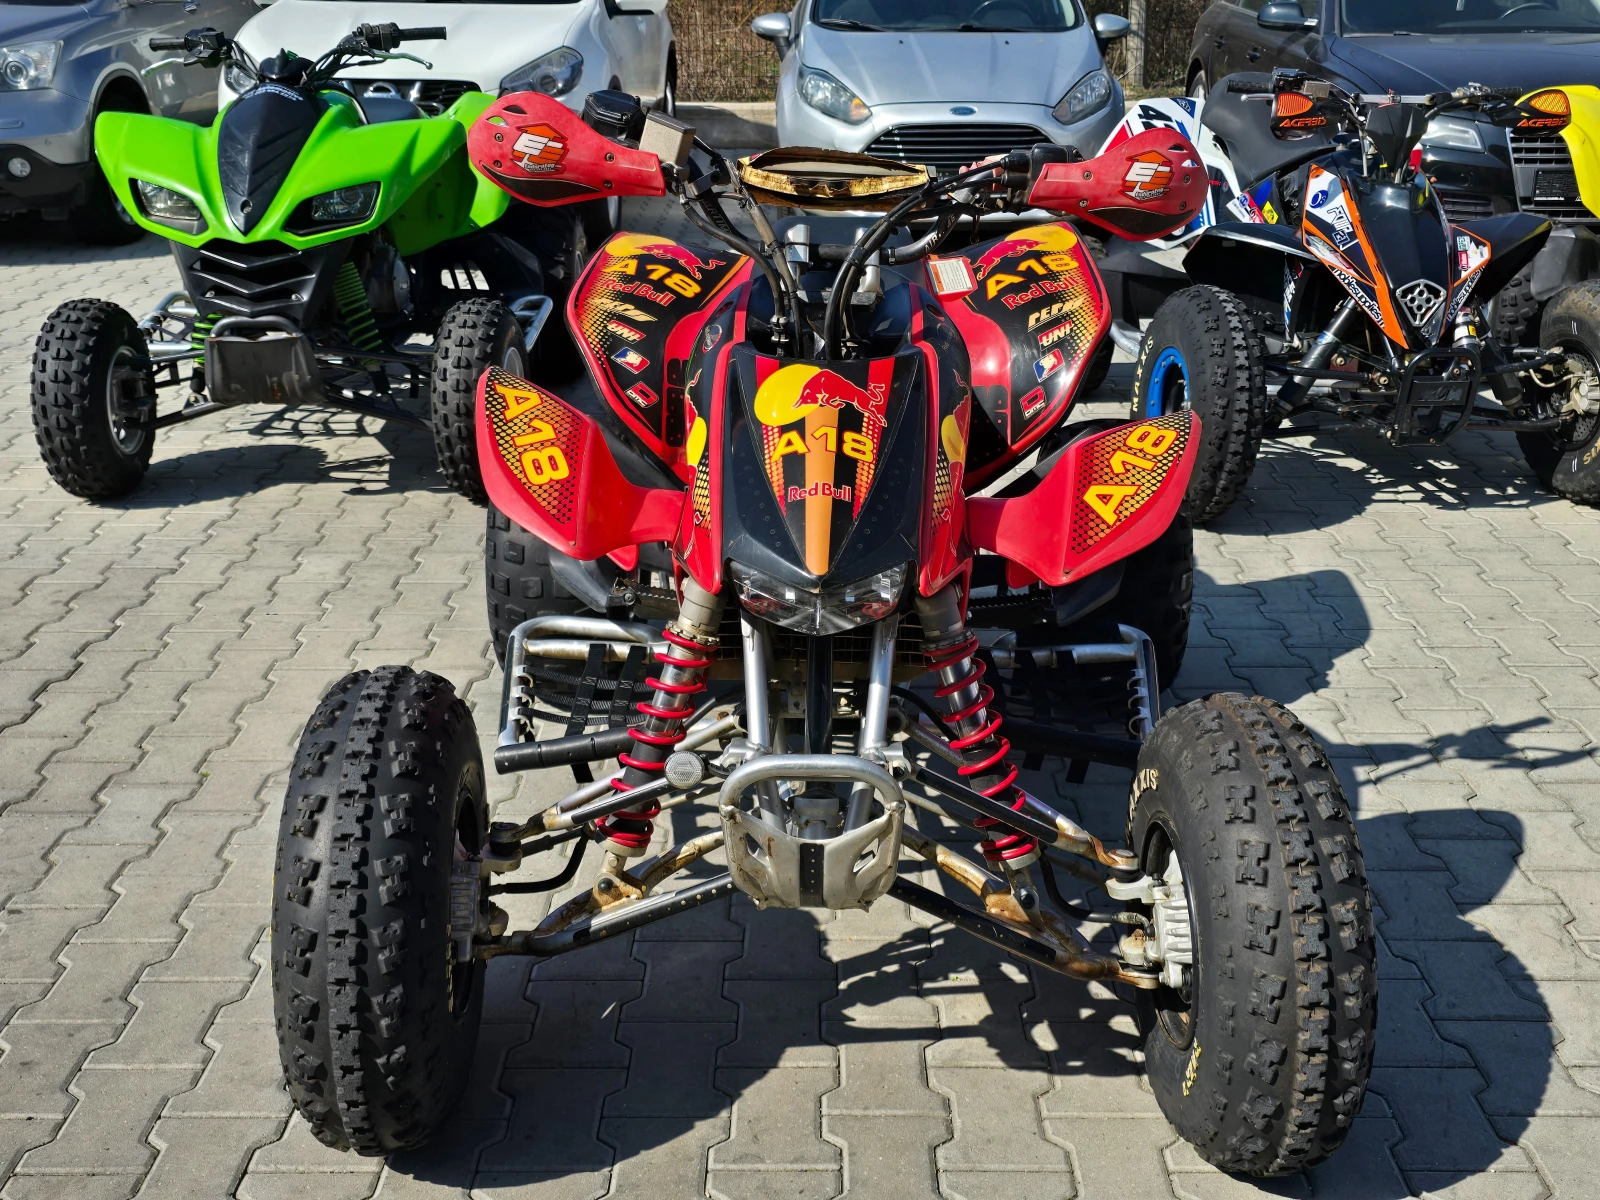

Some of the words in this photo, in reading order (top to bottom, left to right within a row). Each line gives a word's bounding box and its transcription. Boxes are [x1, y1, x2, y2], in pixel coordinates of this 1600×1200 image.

[601, 259, 702, 299] A18
[601, 276, 641, 293] Red
[634, 283, 676, 307] Bull
[987, 254, 1079, 301] A18
[1001, 283, 1045, 310] Red
[1039, 275, 1080, 293] Bull
[1132, 335, 1154, 412] MAXXIS
[493, 382, 570, 487] A18
[771, 425, 874, 463] A18
[788, 482, 819, 502] Red
[821, 482, 852, 502] Bull
[1082, 424, 1179, 527] A18
